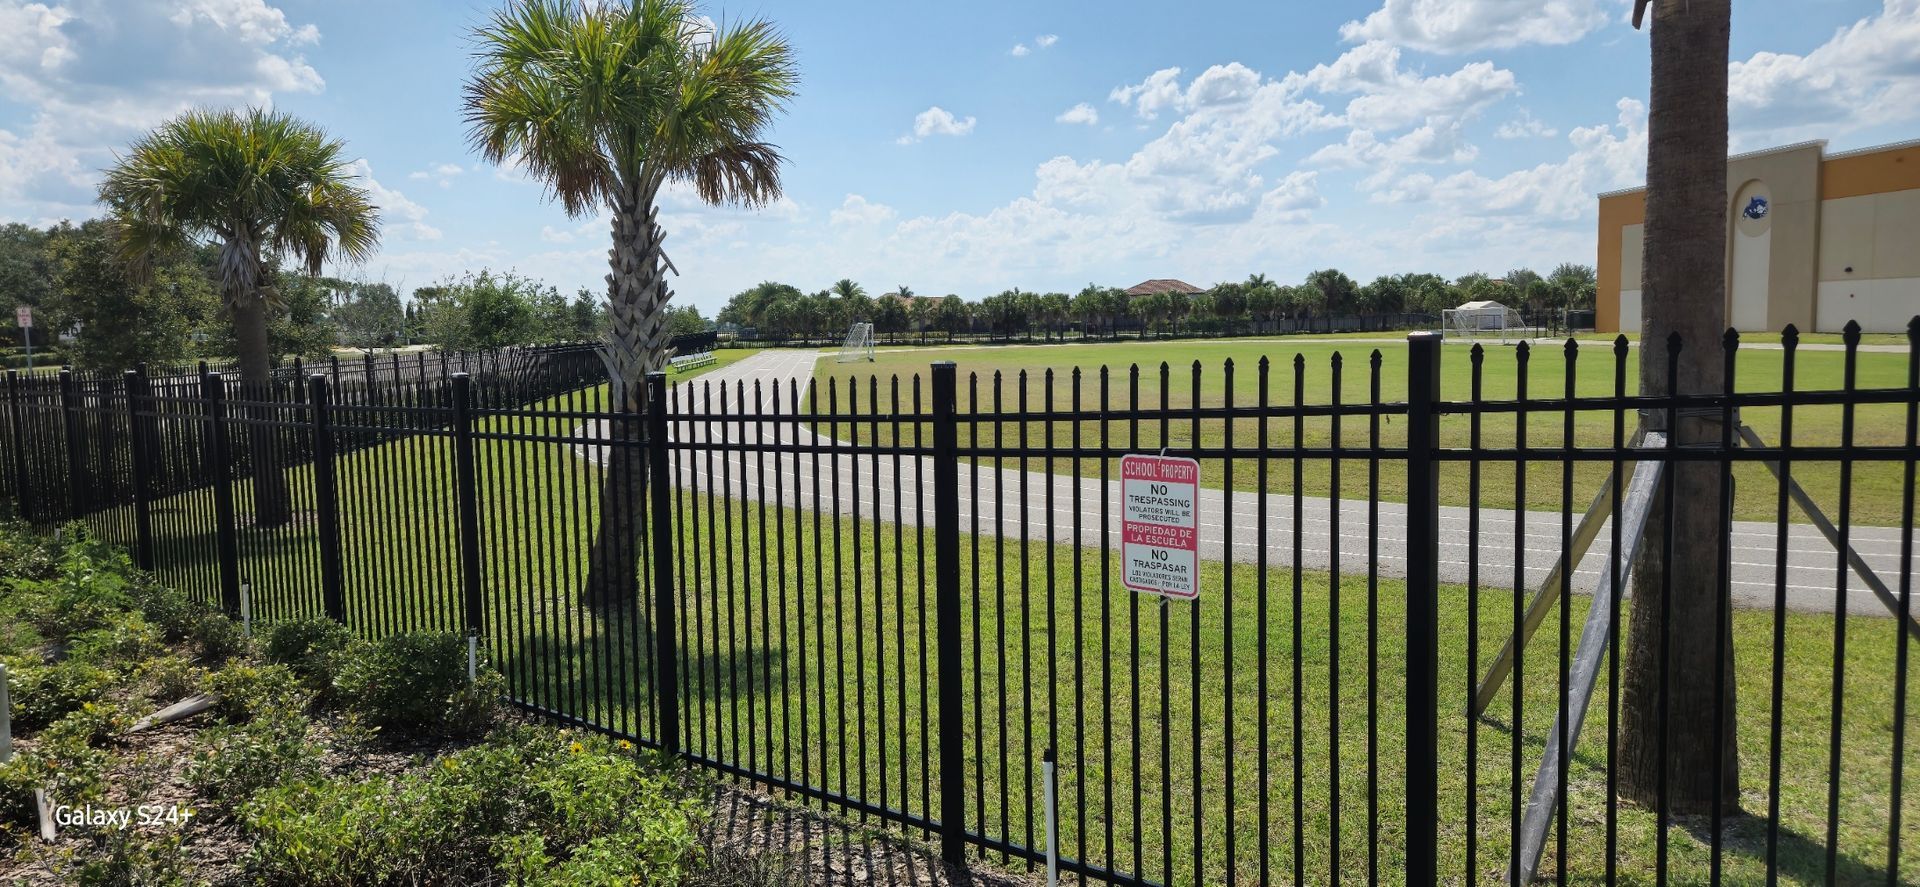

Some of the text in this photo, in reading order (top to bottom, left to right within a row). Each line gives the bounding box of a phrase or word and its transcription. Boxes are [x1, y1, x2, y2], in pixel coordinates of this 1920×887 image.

[1125, 462, 1194, 480] SCHOOL PROPERTY
[1150, 484, 1168, 495] NO
[1129, 495, 1190, 508] TRESPASSING
[1129, 505, 1163, 514] VIOLATORS
[1139, 514, 1179, 523] PROSECUTED
[1127, 524, 1192, 538] PROPIEDAD DE
[1131, 533, 1187, 547] LA ESCUELA
[1151, 549, 1168, 561] NO
[1133, 559, 1187, 573] TRASPASAR
